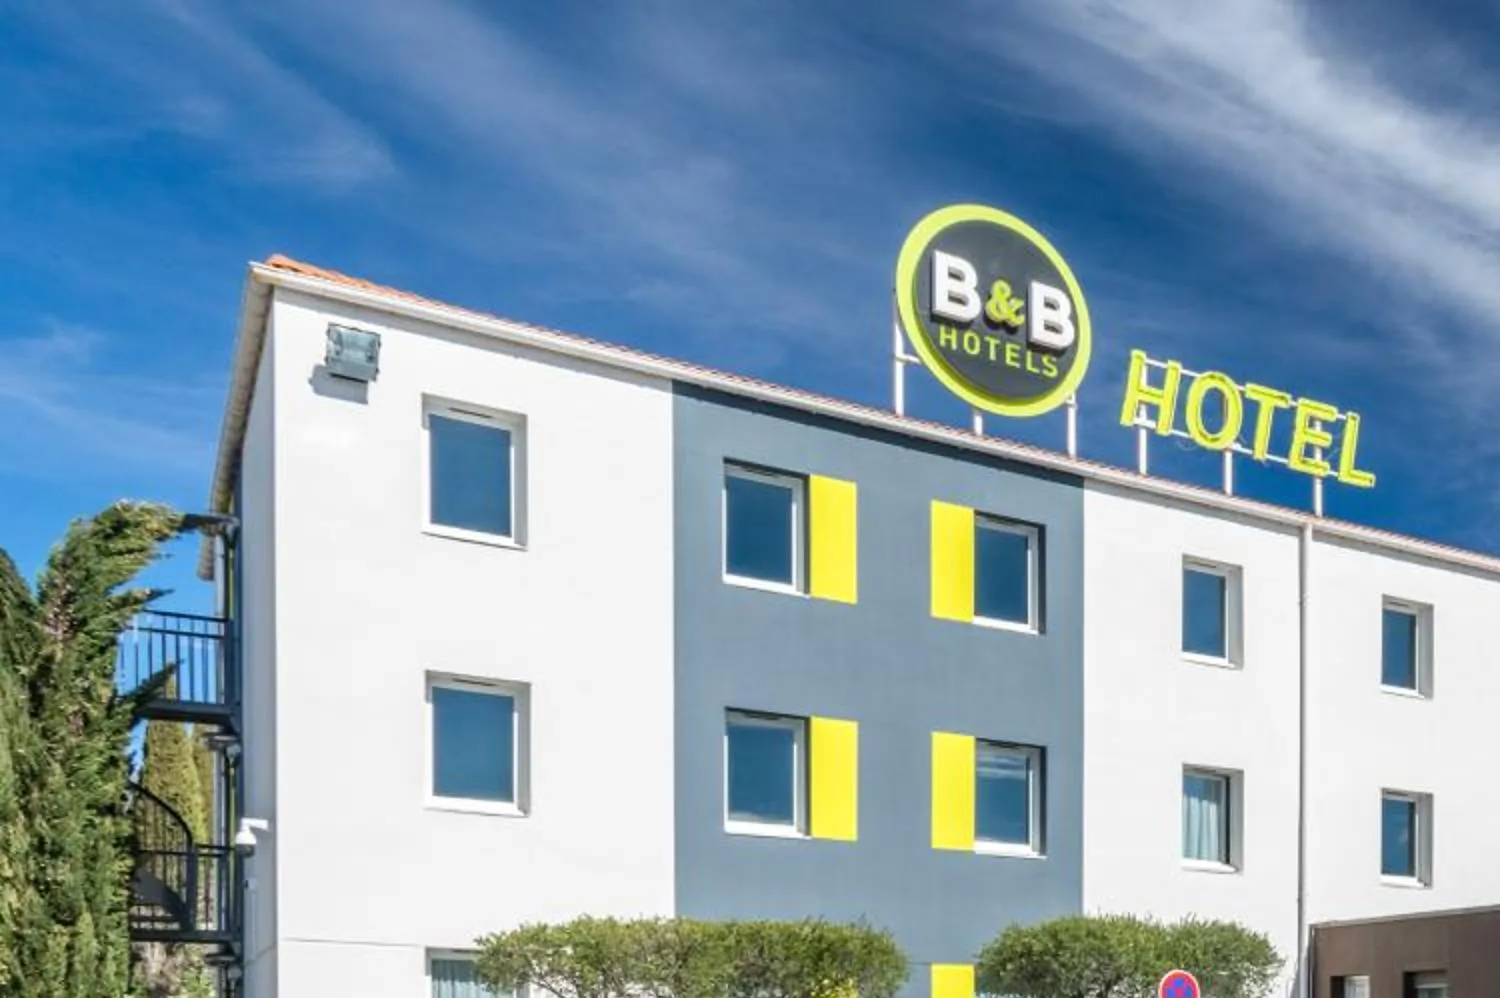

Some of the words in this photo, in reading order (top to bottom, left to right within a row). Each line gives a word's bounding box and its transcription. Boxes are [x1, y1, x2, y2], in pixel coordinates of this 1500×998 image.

[933, 249, 1075, 350] B&B
[939, 324, 1059, 379] HOTELS
[1119, 348, 1376, 489] HOTEL
